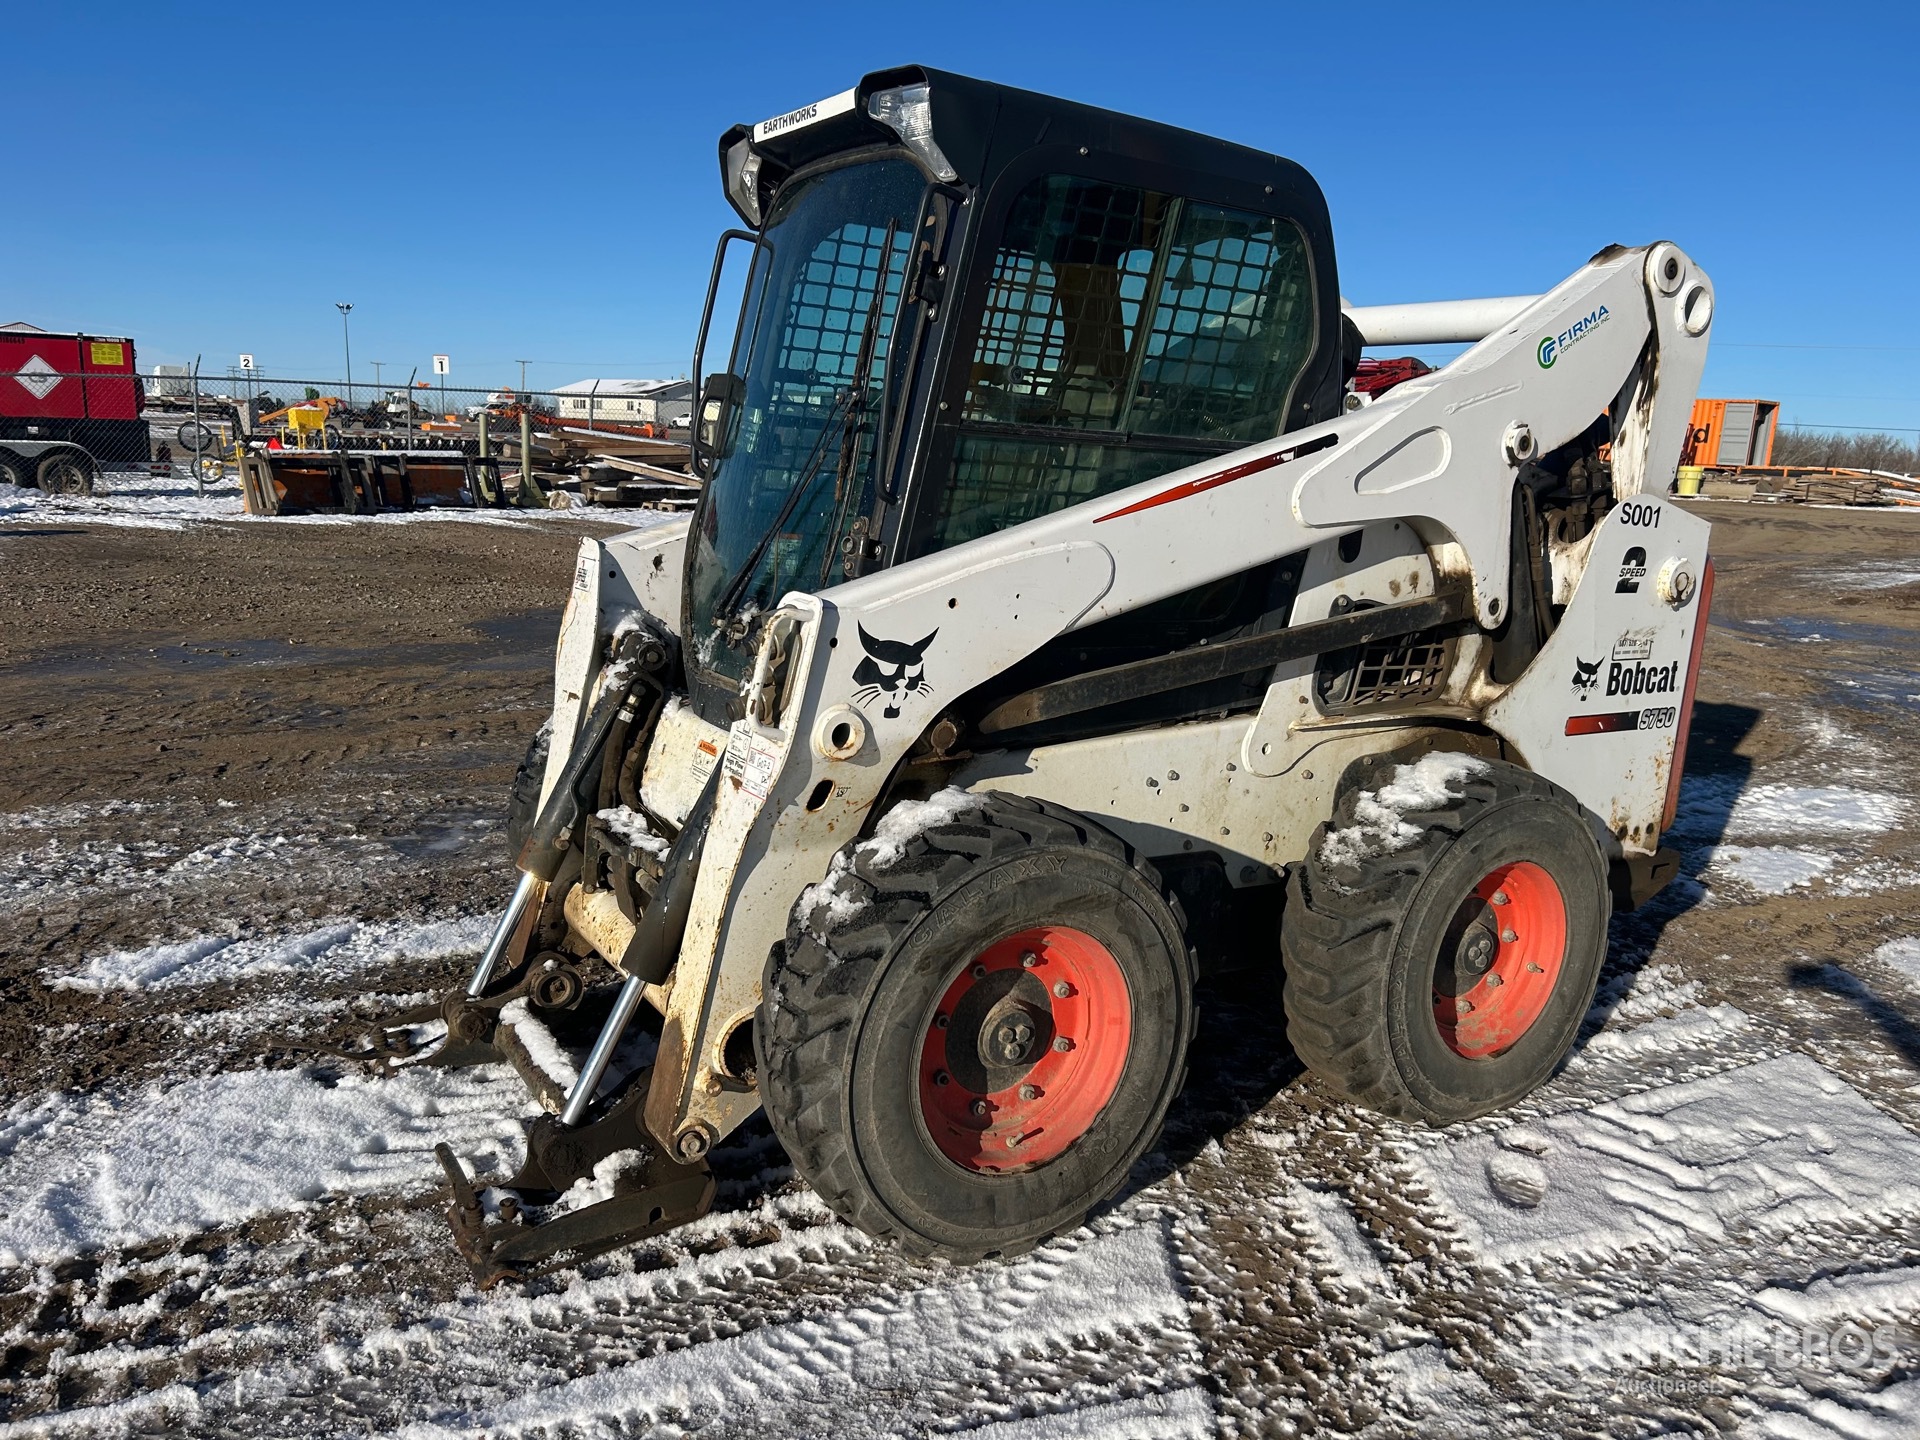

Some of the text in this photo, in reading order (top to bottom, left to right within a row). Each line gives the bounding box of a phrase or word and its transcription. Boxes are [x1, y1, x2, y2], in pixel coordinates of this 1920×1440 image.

[763, 104, 817, 134] EARTHWORKS
[1558, 305, 1609, 347] FIRMA
[1560, 315, 1611, 354] CONTRACTING INC
[243, 358, 250, 368] 2
[438, 360, 444, 372] 1
[1620, 502, 1661, 529] S001
[1619, 567, 1647, 578] SPEED
[1606, 660, 1678, 696] Bobcat
[1639, 707, 1676, 730] S750
[908, 855, 1068, 949] GALAXY
